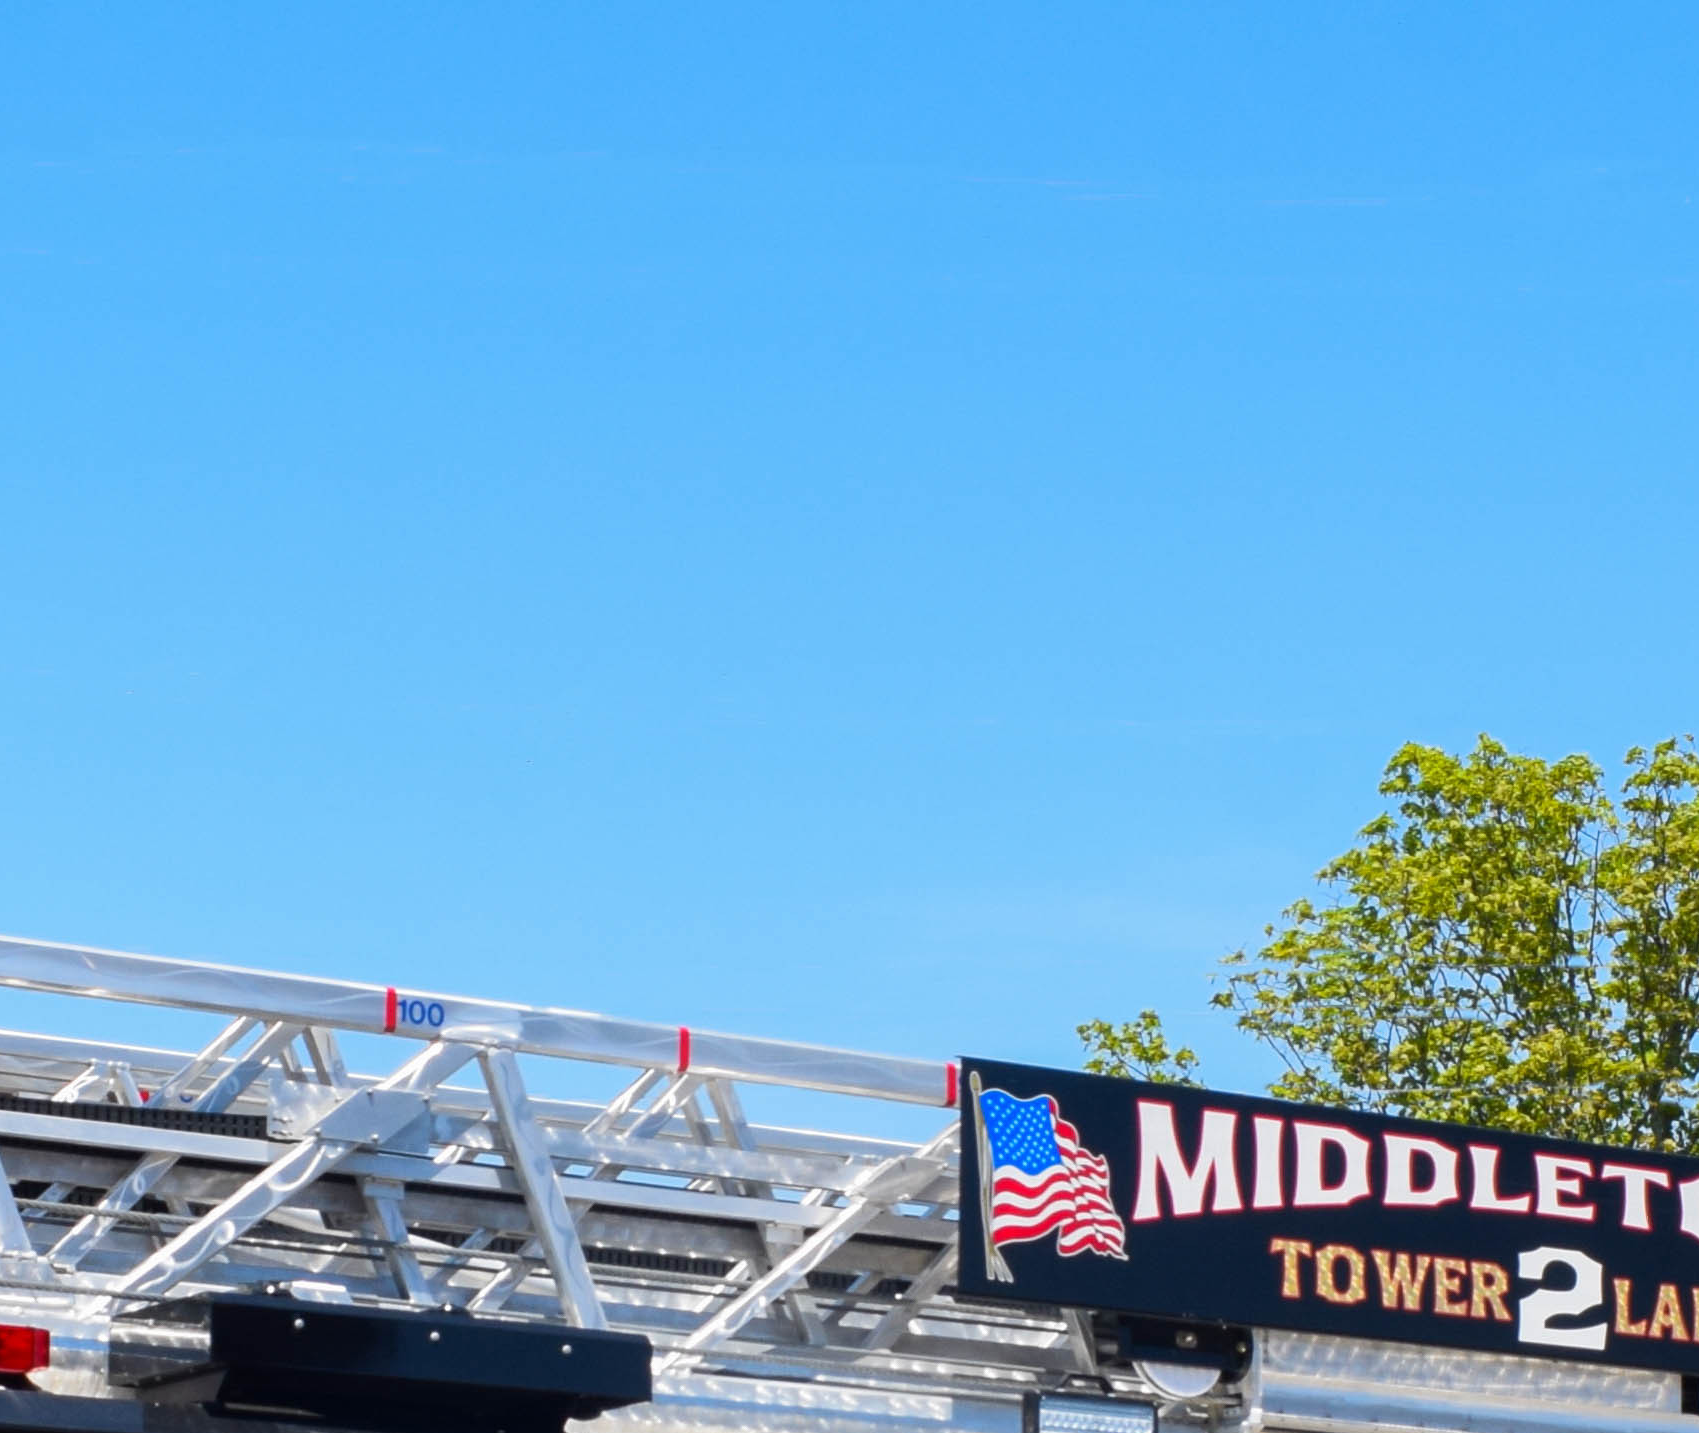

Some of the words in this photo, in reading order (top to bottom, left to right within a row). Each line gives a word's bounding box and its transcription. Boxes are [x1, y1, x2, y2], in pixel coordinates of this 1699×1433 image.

[398, 1000, 445, 1027] 100
[1269, 1236, 1513, 1322] TOWER
[1517, 1246, 1608, 1351] 2
